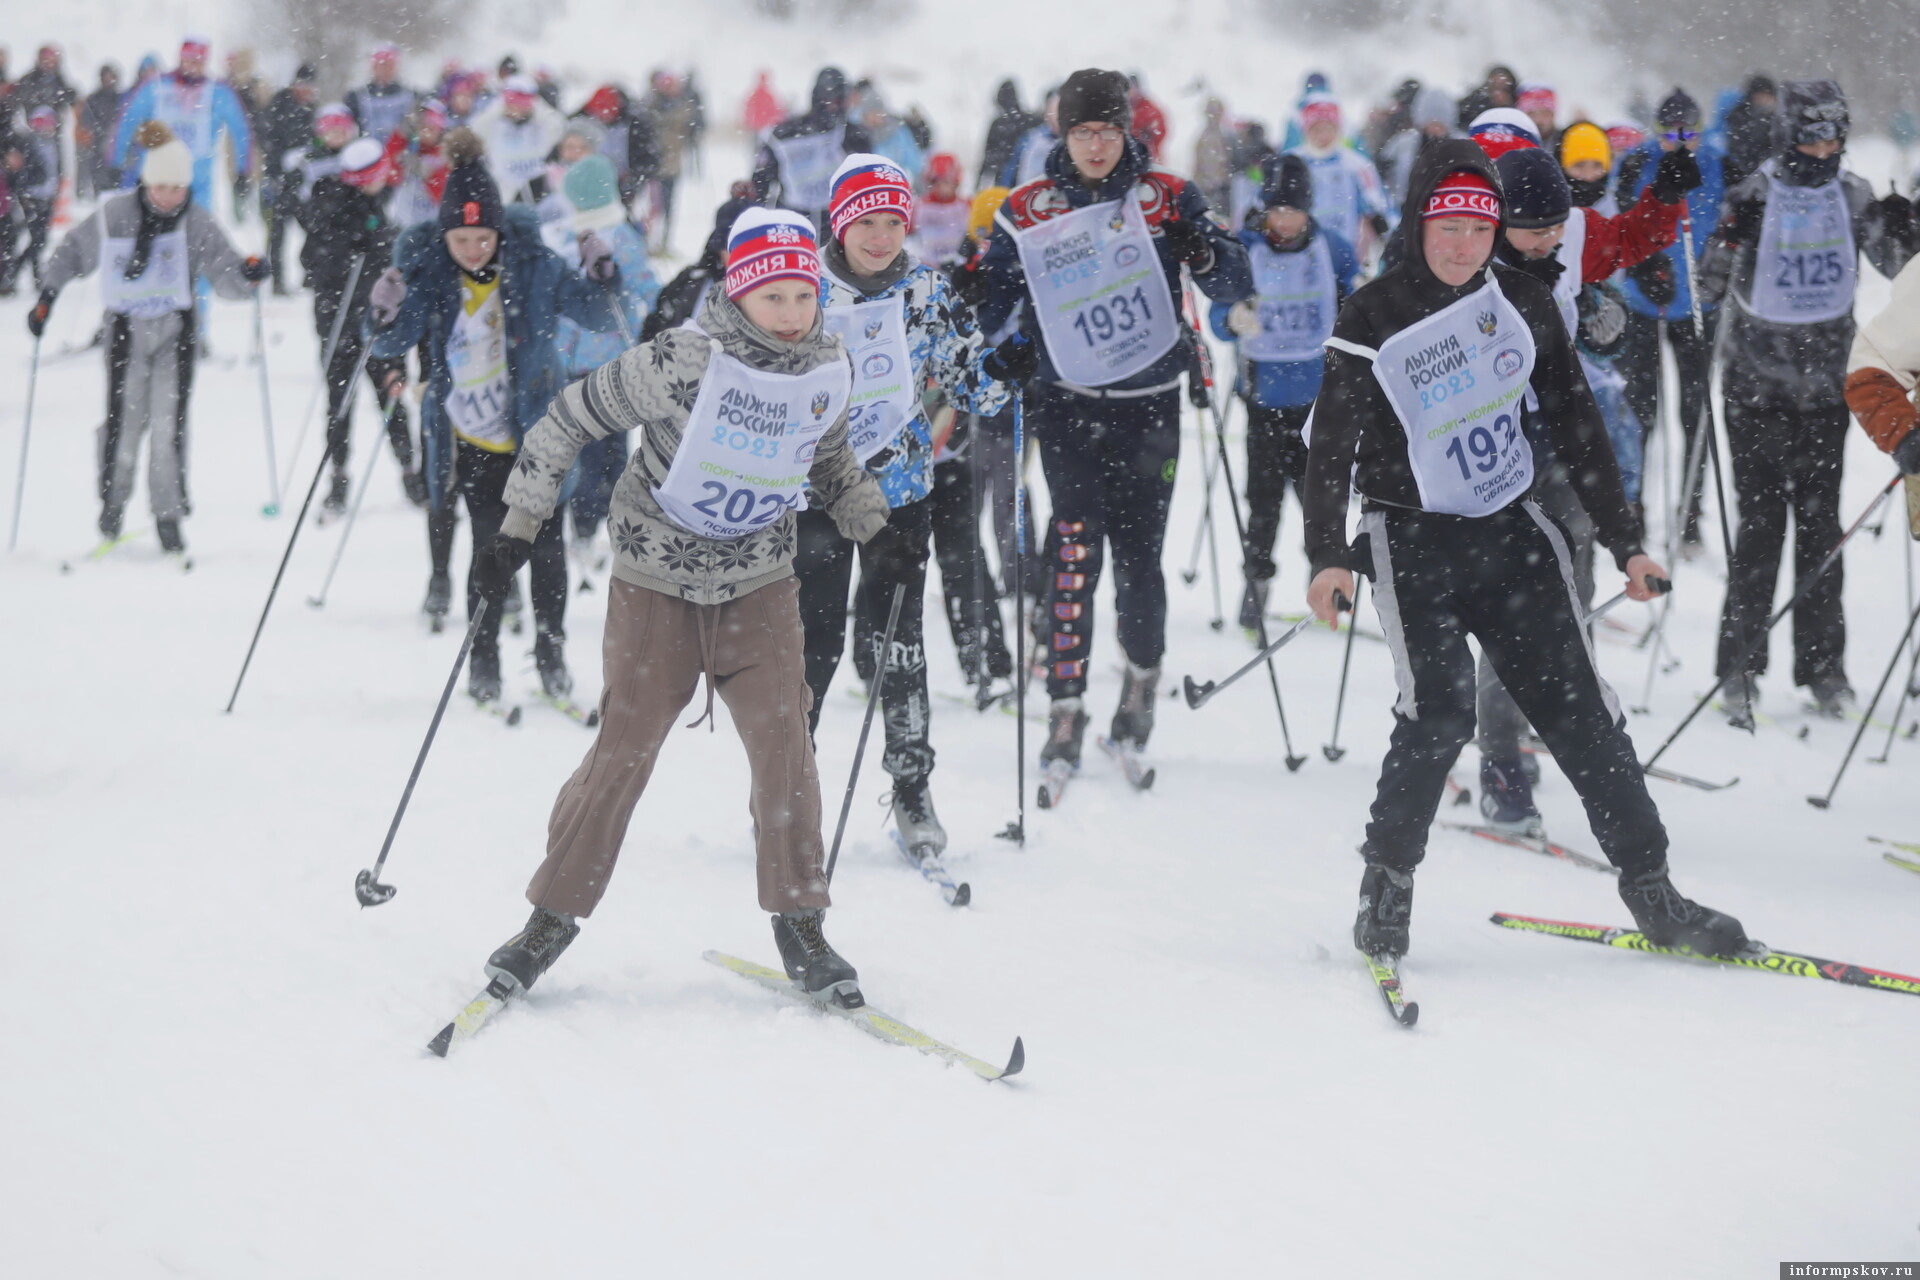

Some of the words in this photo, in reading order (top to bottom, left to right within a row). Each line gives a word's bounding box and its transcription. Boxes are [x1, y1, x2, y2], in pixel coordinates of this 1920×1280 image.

[1430, 193, 1499, 211] РОССИ
[1776, 252, 1843, 287] 2125
[1074, 286, 1152, 347] 1931
[1404, 334, 1460, 375] ЛЫЖНЯ
[1409, 350, 1469, 390] РОССИИ
[720, 387, 788, 419] ЛЫЖНЯ
[864, 384, 902, 401] ЖИЗНИ
[1420, 368, 1476, 410] 2023
[717, 404, 786, 437] РОССИИ
[1427, 419, 1460, 440] СПОРТ
[1465, 396, 1505, 422] НОРМА
[710, 425, 780, 459] 2023
[700, 461, 736, 480] СПОРТ
[744, 474, 786, 488] НОРМА
[1483, 468, 1525, 503] ОБЛАСТЬ
